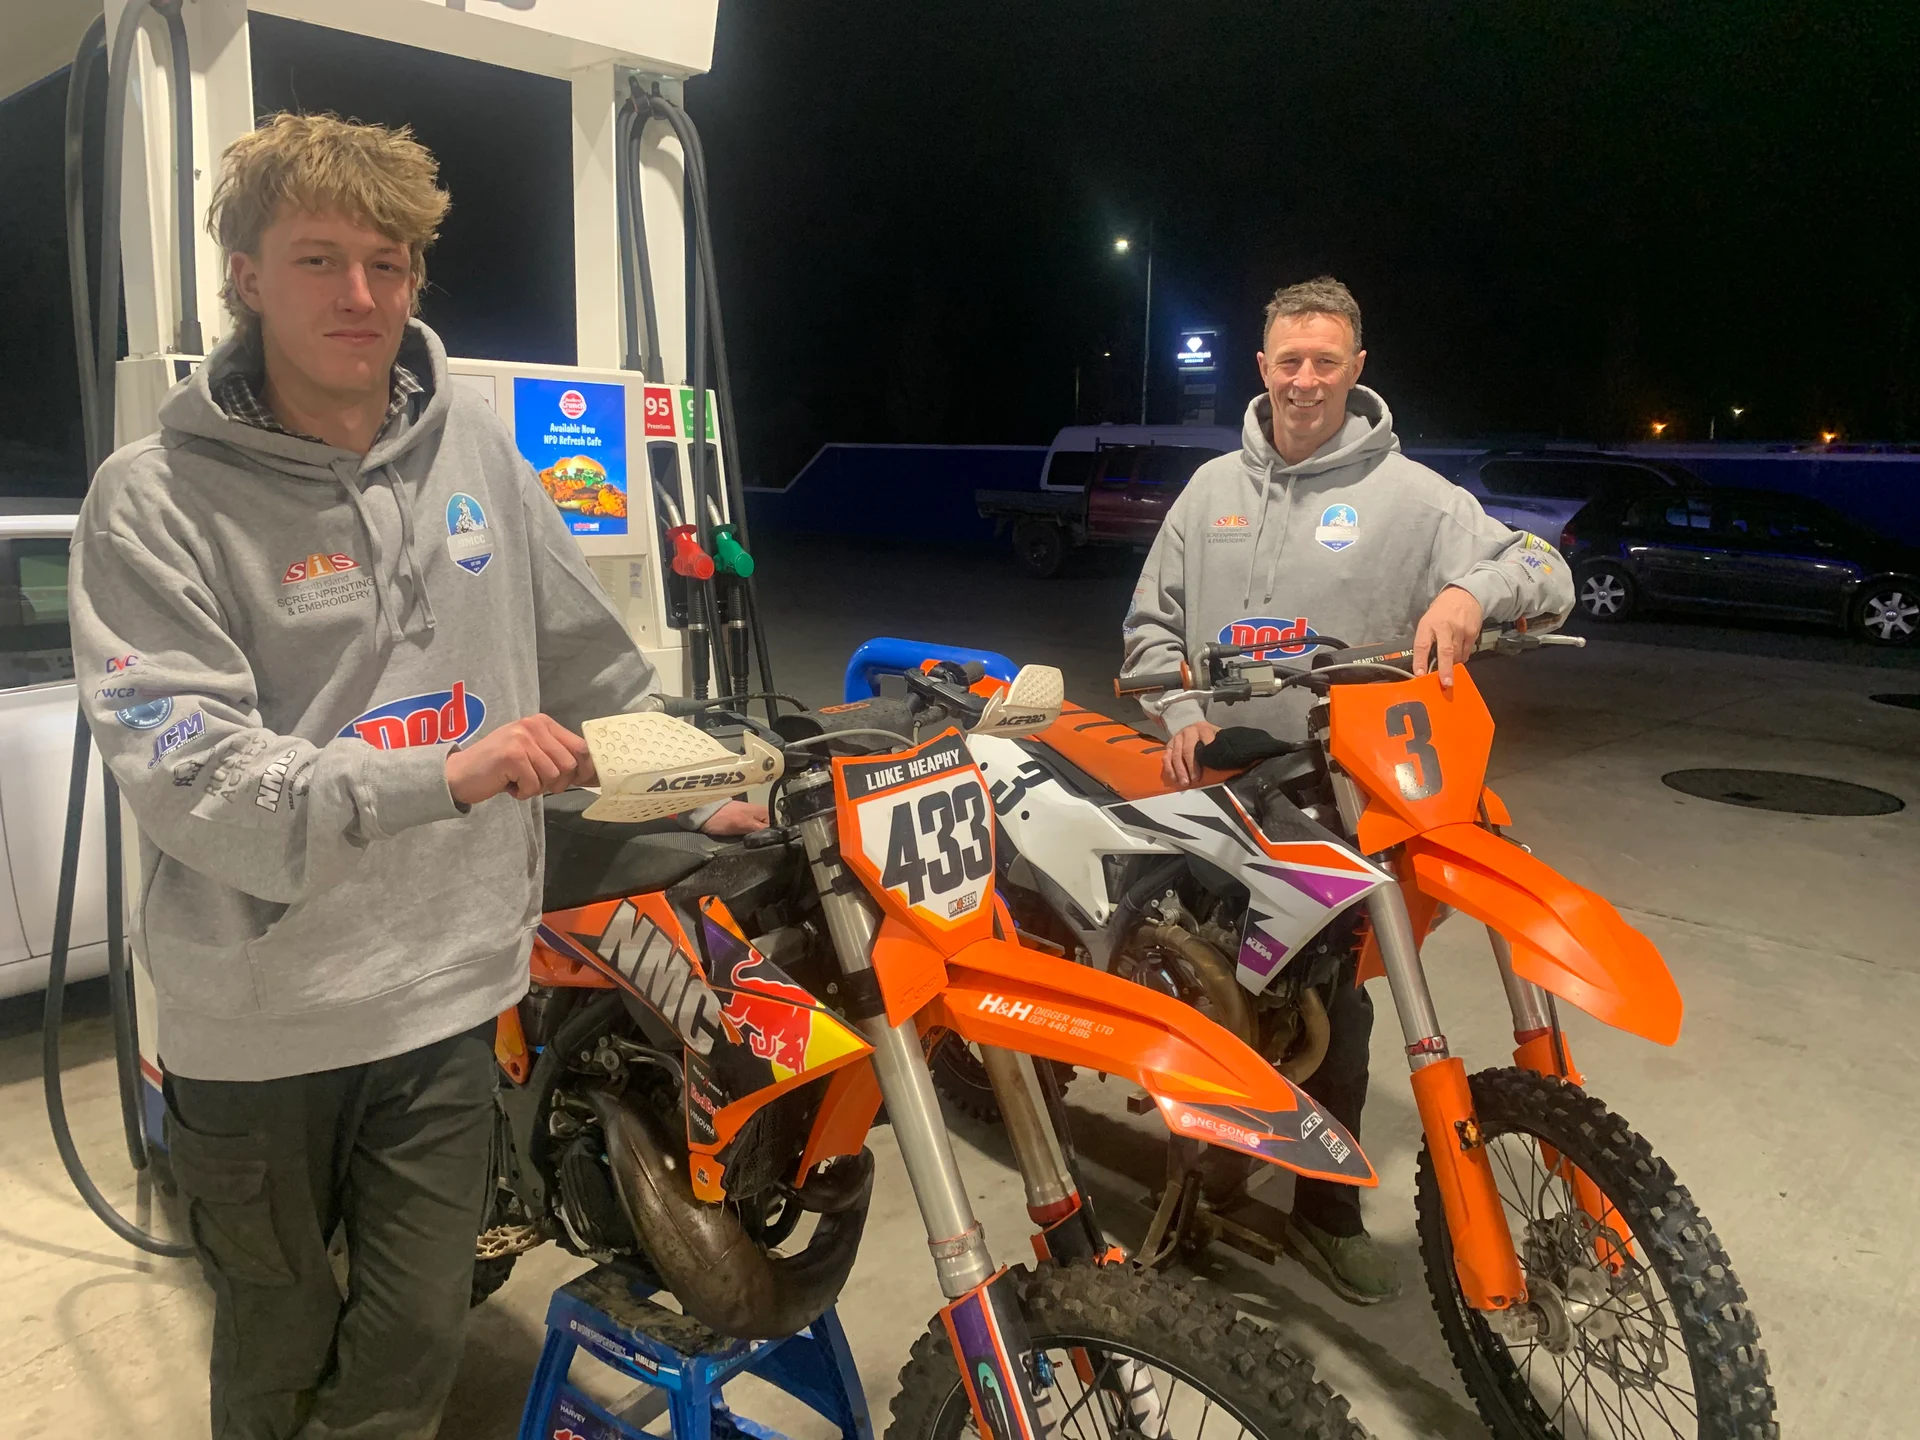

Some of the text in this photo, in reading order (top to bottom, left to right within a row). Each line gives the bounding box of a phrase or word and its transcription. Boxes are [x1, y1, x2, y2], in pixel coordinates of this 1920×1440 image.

[645, 397, 670, 417] 95
[550, 422, 597, 435] Available Now
[646, 422, 671, 431] Premium
[543, 434, 602, 447] NPD Refresh Cafe
[277, 576, 377, 608] SCREENPRINTING
[296, 573, 350, 594] South Island
[287, 589, 370, 617] & EMBROIDERY
[1385, 701, 1443, 802] 3
[646, 771, 746, 793] ACERBIS
[865, 749, 960, 791] LUKE HEAPHY
[882, 781, 993, 906] 433
[1245, 936, 1273, 961] KTM
[597, 898, 722, 1055] NMC
[977, 993, 1114, 1036] H&H DIGGER HIRE LTD
[1028, 1015, 1092, 1039] 021 446 886
[1196, 1117, 1245, 1138] NELSON
[560, 1404, 586, 1423] HARVEY
